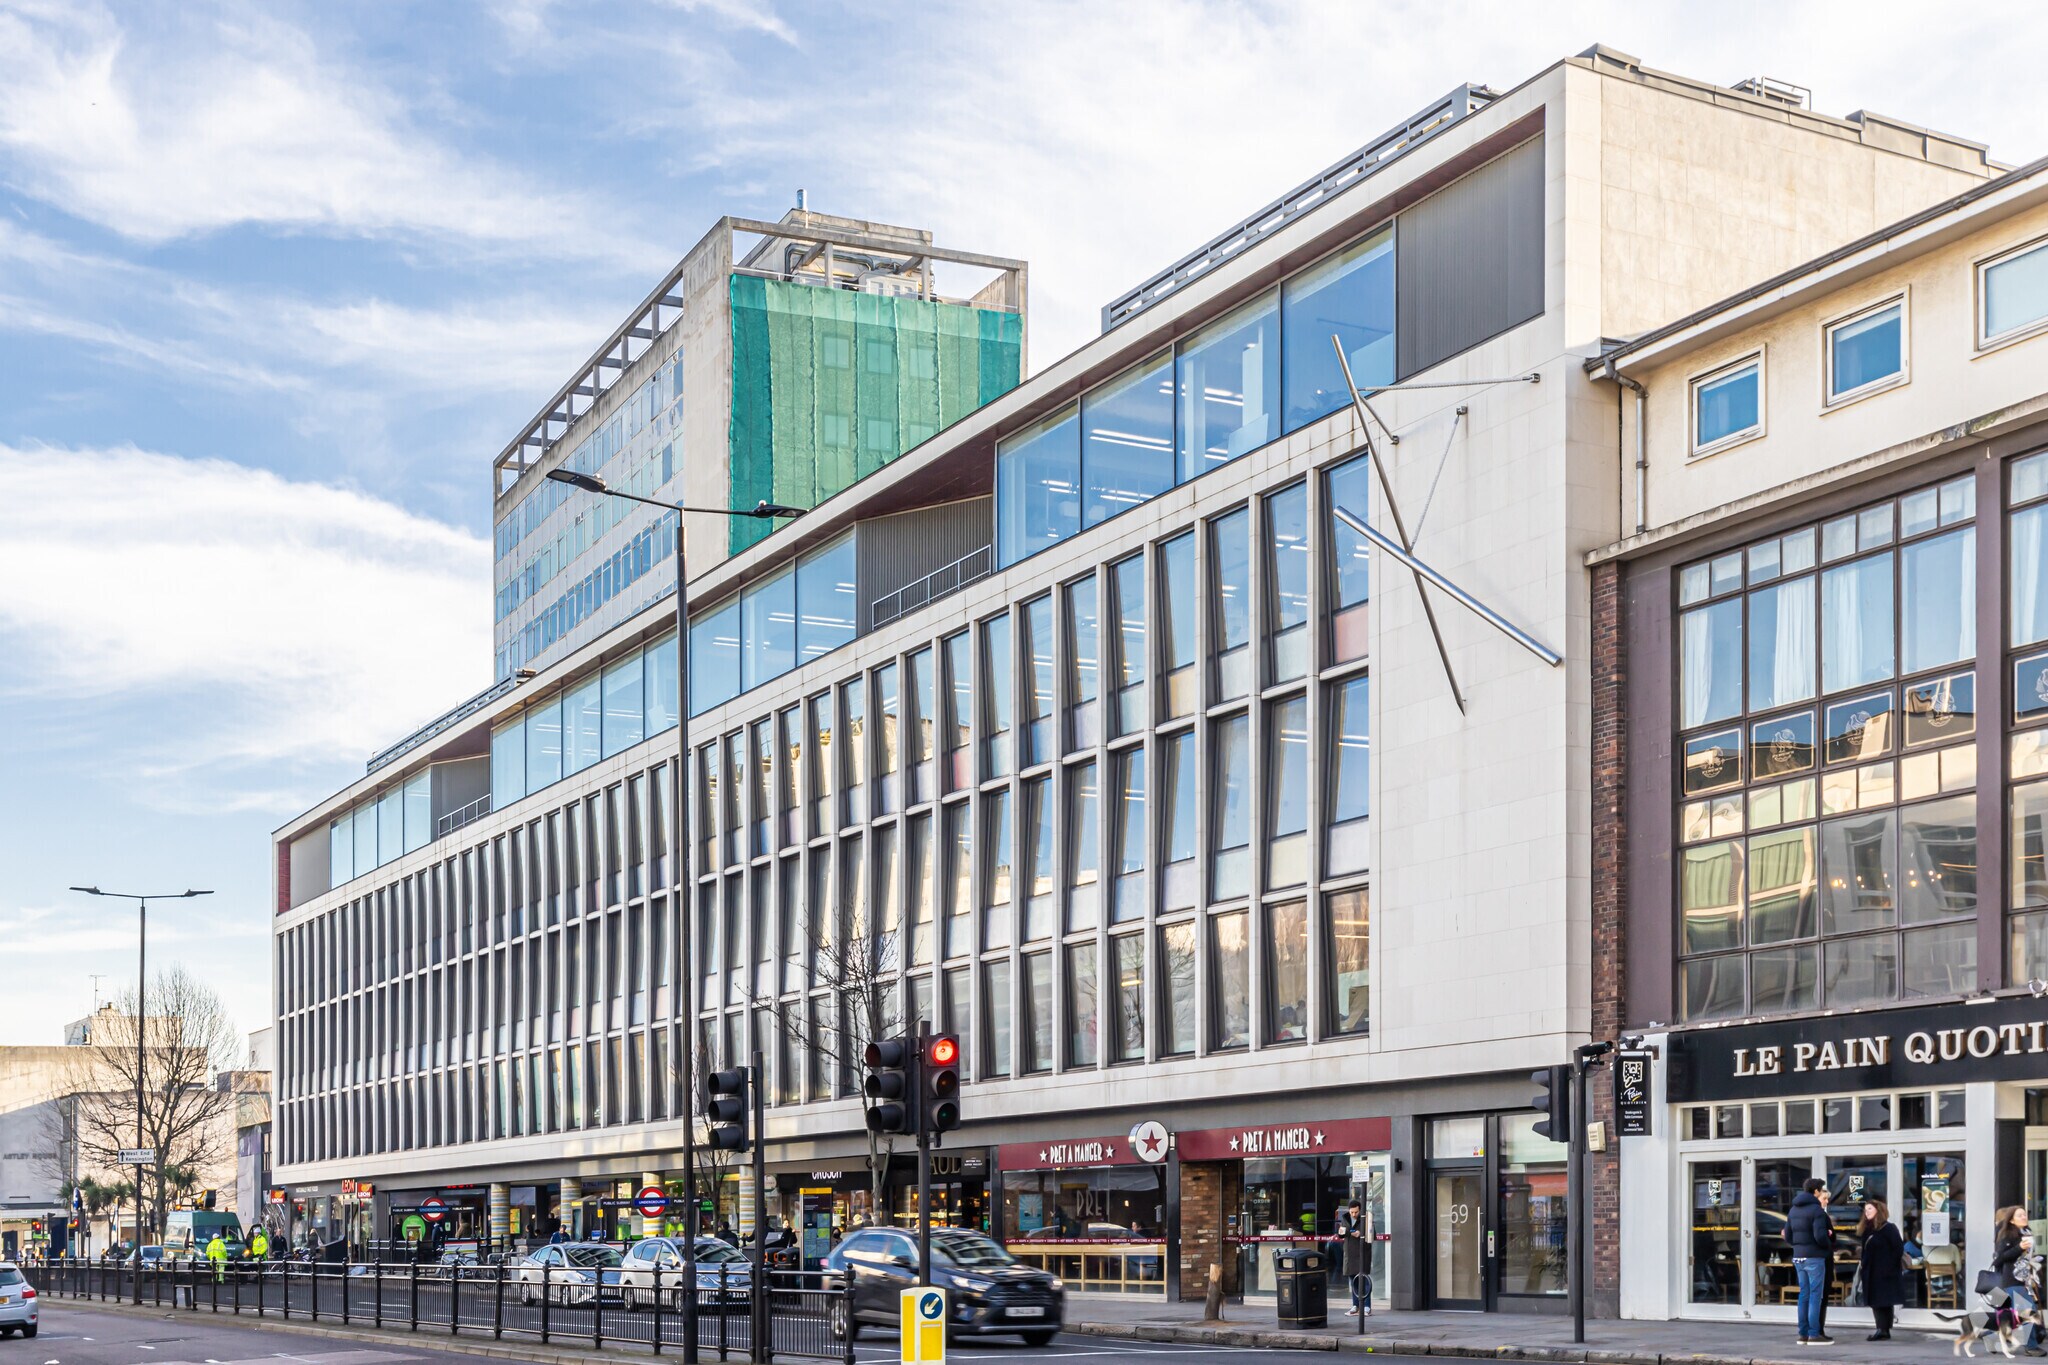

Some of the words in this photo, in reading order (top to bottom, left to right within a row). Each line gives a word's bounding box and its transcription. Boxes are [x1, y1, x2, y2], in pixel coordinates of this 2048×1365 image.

[1733, 1046, 1781, 1077] LE
[1793, 1036, 1890, 1073] PAIN
[1904, 1021, 2048, 1064] QUOTI
[1242, 1131, 1263, 1153] PRET
[1265, 1130, 1272, 1152] A
[1274, 1128, 1310, 1151] MANGER
[1050, 1145, 1066, 1164] PRET
[1067, 1144, 1073, 1163] A
[1074, 1143, 1103, 1163] MANGER
[929, 1157, 961, 1175] AUL
[342, 1179, 355, 1193] LEON
[1450, 1204, 1468, 1224] 69
